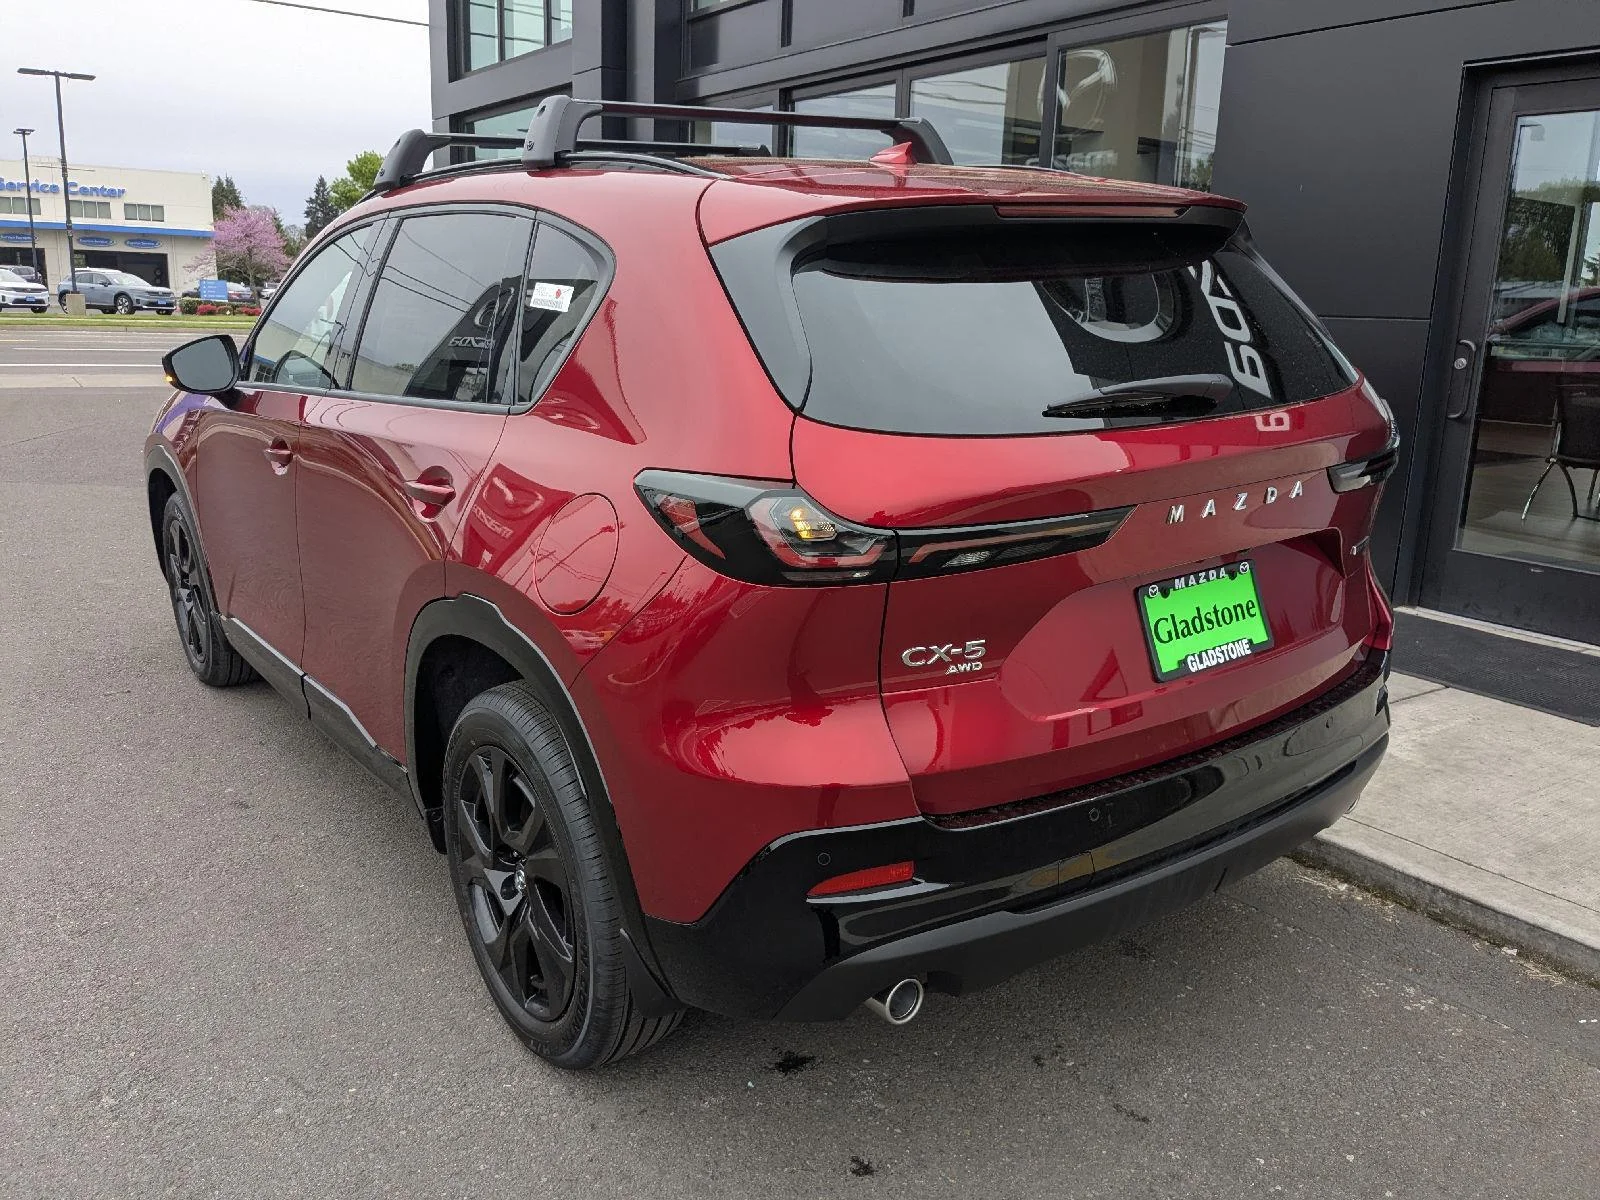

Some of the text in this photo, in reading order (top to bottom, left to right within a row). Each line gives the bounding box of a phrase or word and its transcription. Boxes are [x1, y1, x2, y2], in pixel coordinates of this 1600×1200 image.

[67, 181, 126, 198] Center
[1168, 481, 1303, 524] MAZDA
[1174, 567, 1227, 590] MAZDA
[1153, 599, 1257, 645] Gladstone
[901, 639, 987, 667] CX-5
[1186, 638, 1252, 673] GLADSTONE
[945, 661, 983, 675] AWD
